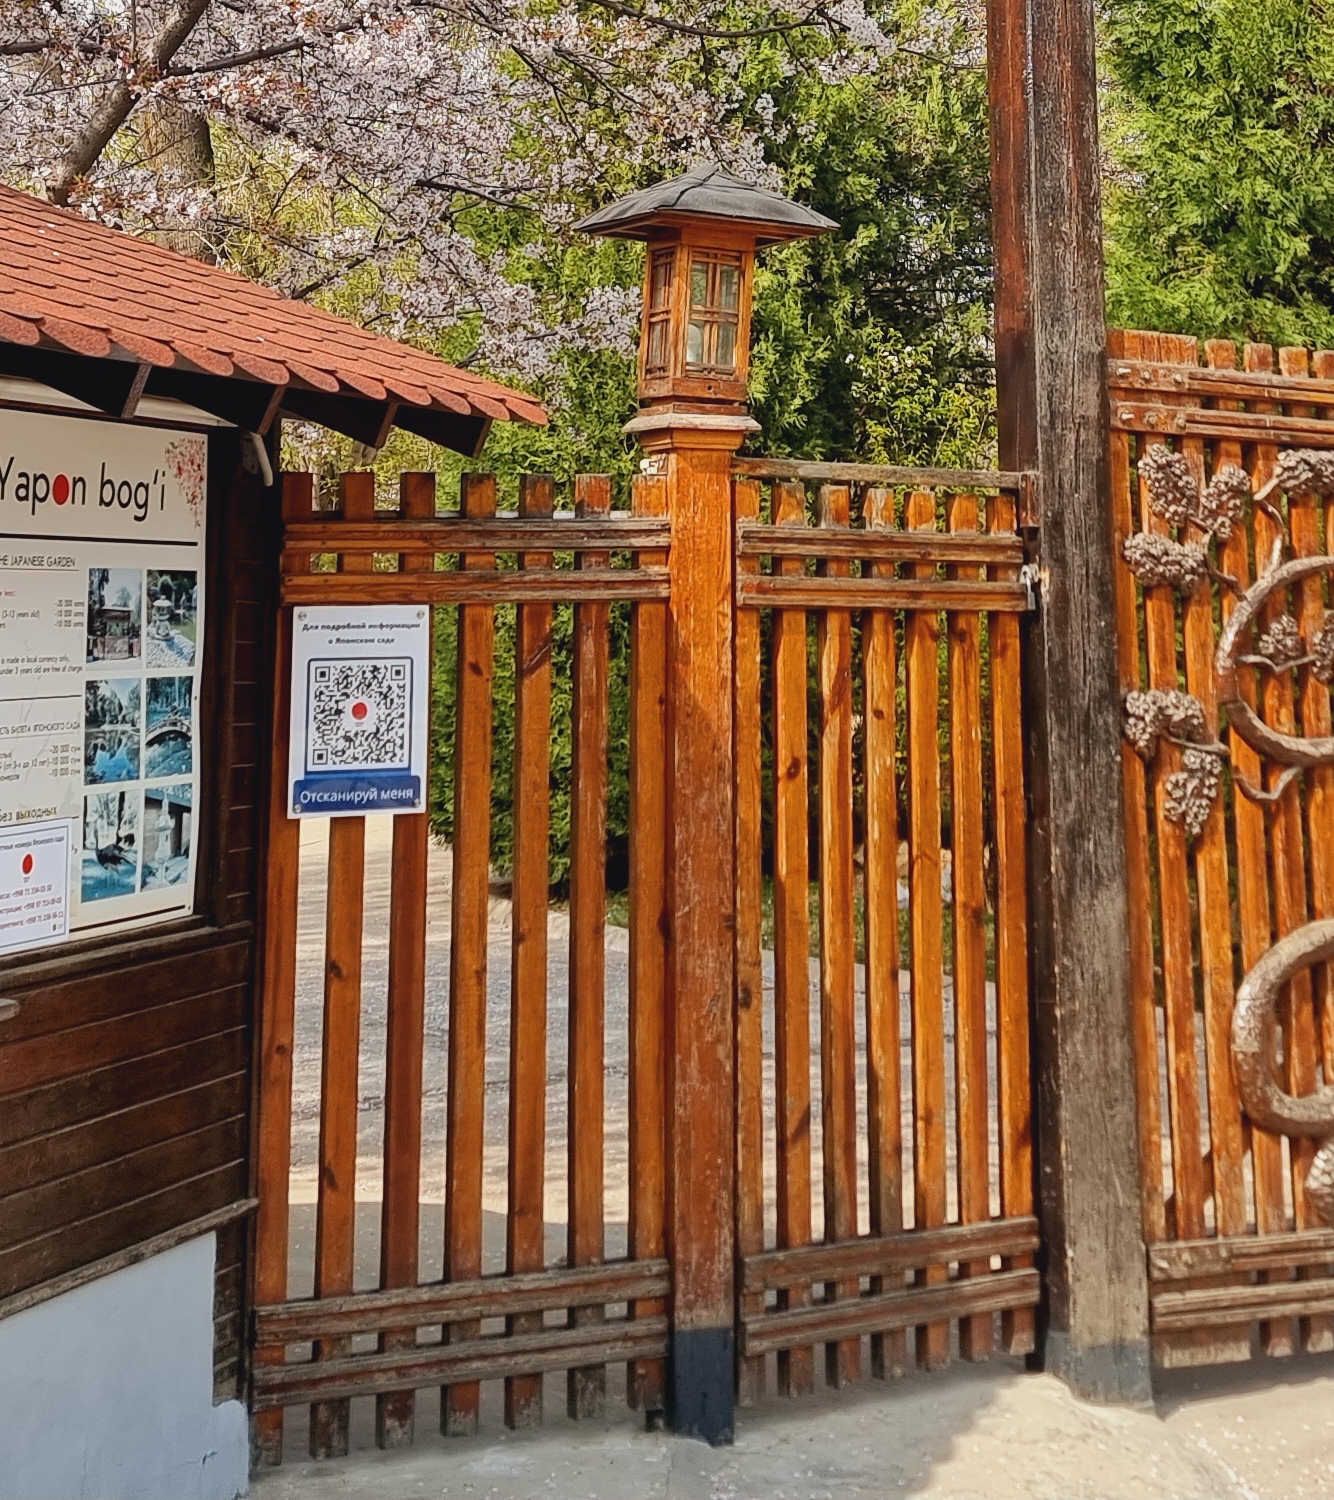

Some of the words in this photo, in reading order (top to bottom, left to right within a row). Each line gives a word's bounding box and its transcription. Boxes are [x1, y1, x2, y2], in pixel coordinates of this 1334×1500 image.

[11, 555, 45, 566] JAPANESE
[47, 556, 76, 567] GARDEN
[302, 623, 319, 632] Для
[320, 622, 366, 632] подробной
[368, 622, 420, 631] информации
[335, 637, 375, 645] Японском
[26, 655, 37, 663] local
[38, 657, 58, 665] currency
[0, 667, 13, 675] under
[20, 668, 32, 676] years
[11, 725, 31, 734] БИЛЕТА
[33, 723, 64, 733] ЯПОНСКОГО
[66, 721, 80, 730] САДА
[300, 787, 378, 804] Отсканируй
[380, 787, 414, 800] меня
[16, 806, 57, 821] выходных
